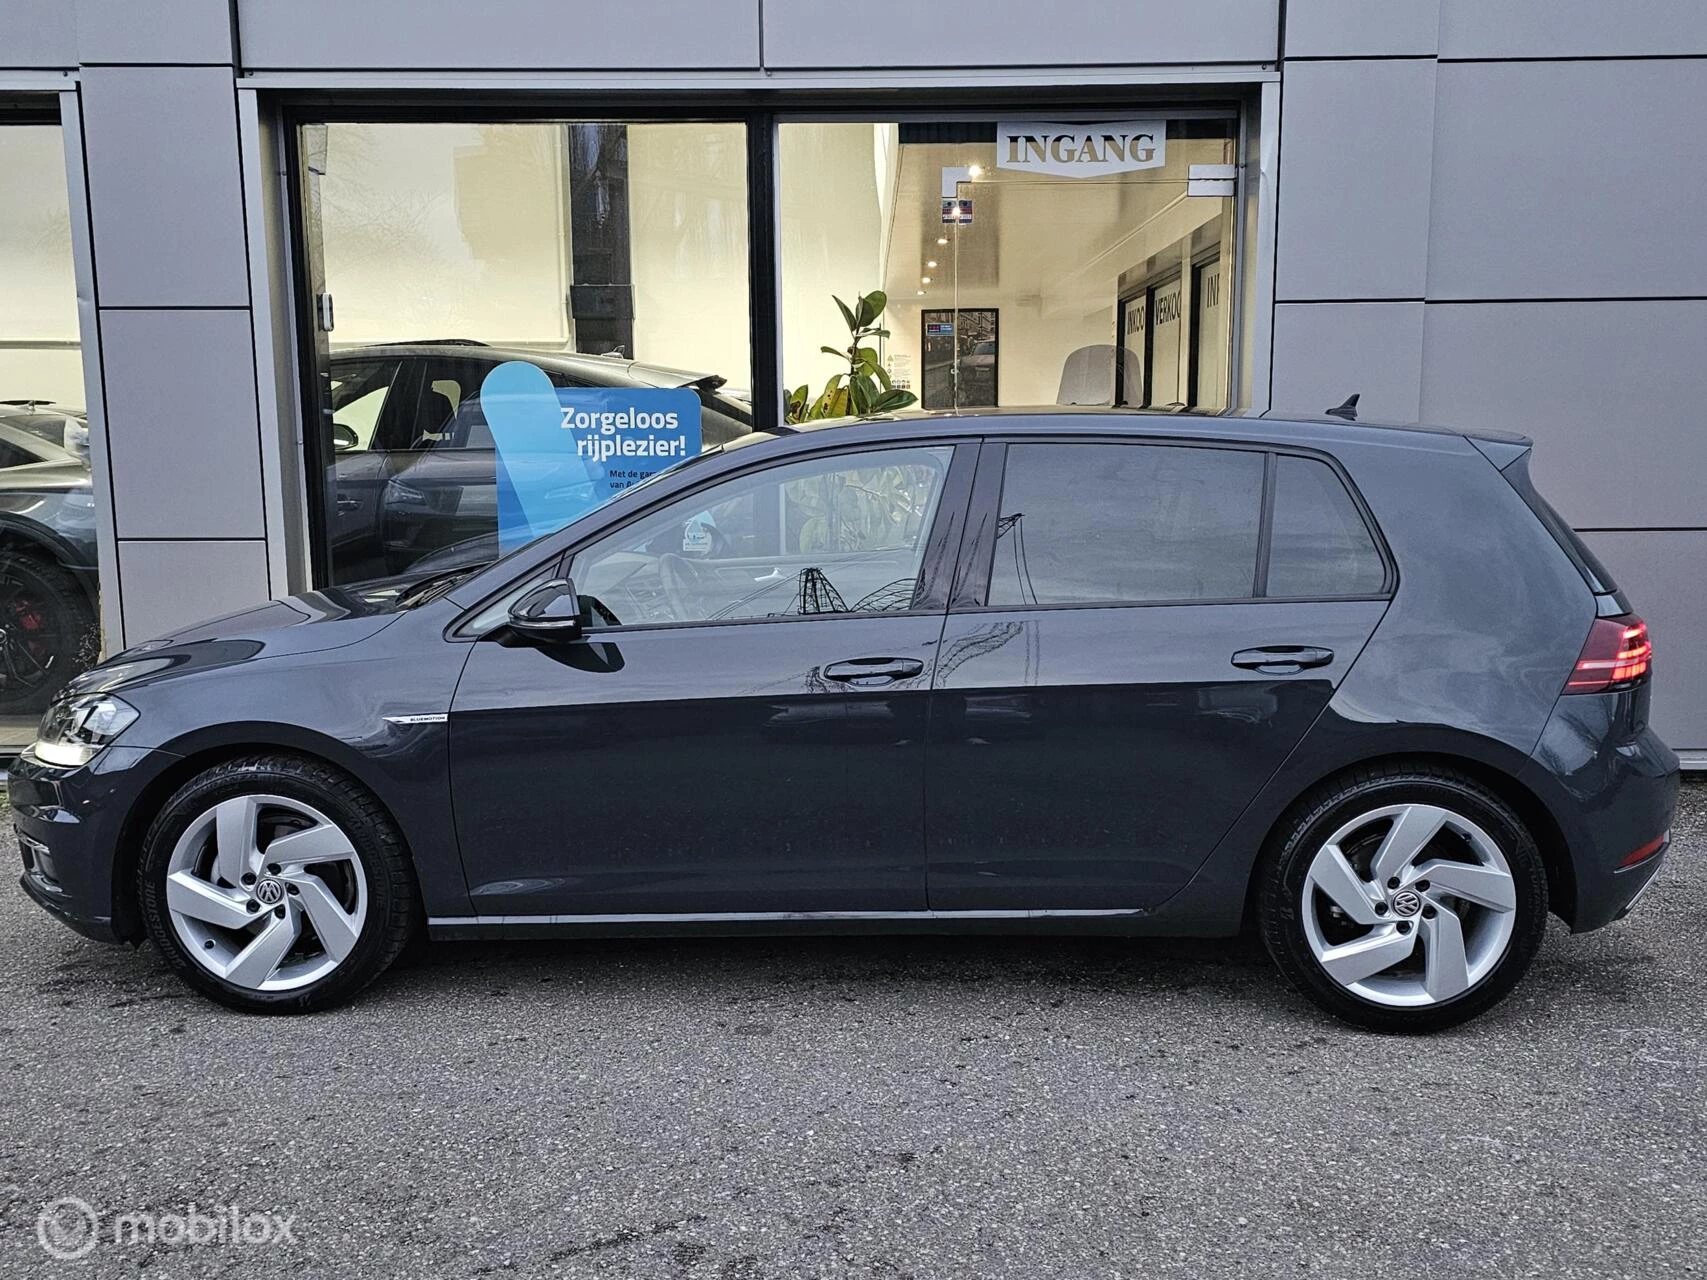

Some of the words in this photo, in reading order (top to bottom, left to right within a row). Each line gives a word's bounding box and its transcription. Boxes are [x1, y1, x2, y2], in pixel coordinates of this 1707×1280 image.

[1006, 134, 1156, 163] INGANG
[559, 406, 679, 434] Zorgeloos
[577, 435, 686, 463] rijplezier!
[609, 469, 626, 478] Met
[628, 469, 638, 478] de
[144, 878, 186, 970] BRIDGESTONE
